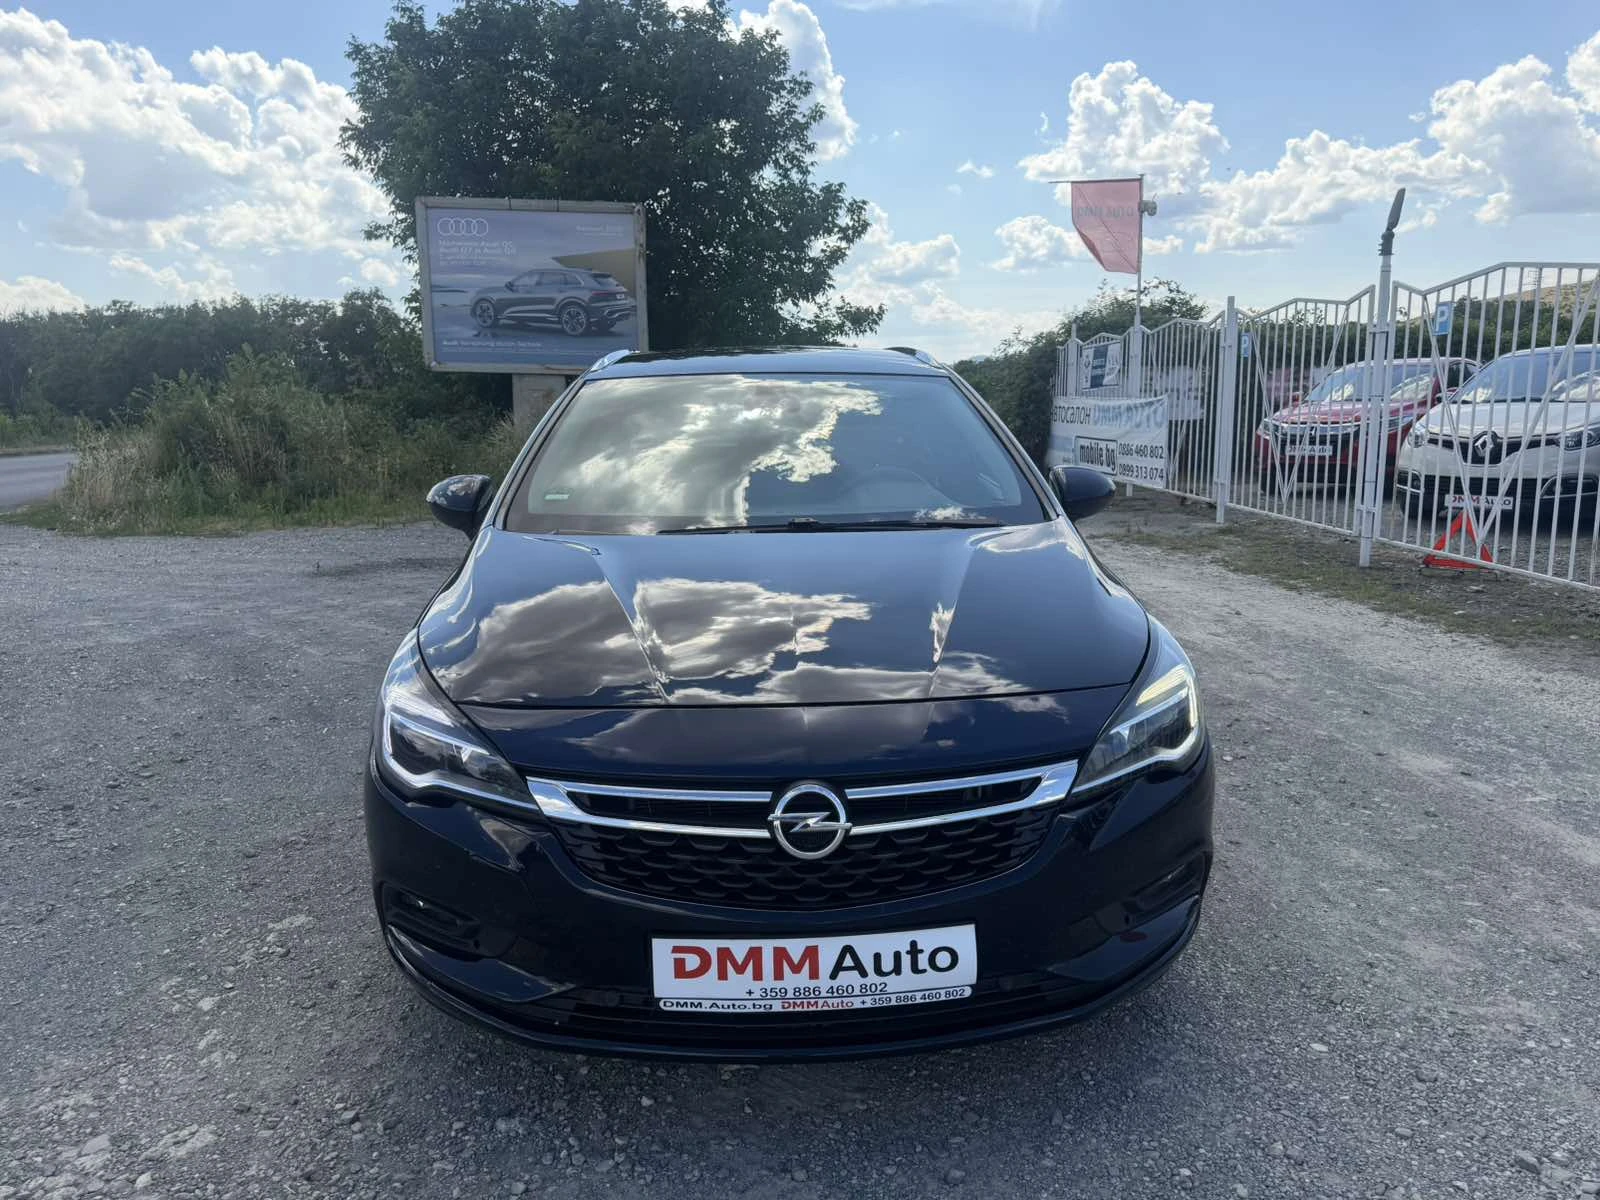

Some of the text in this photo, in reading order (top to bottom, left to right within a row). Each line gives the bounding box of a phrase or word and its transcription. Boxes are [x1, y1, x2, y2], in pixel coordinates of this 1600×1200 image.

[1119, 443, 1164, 459] 0886 460 802
[1119, 463, 1164, 480] 0899 313 074
[793, 986, 821, 997] 886
[826, 984, 855, 996] 460
[859, 982, 887, 994] 802
[663, 1000, 773, 1011] DMM.Auto.bg
[895, 994, 917, 1004] 886
[920, 991, 941, 1001] 460
[944, 988, 966, 999] 802
